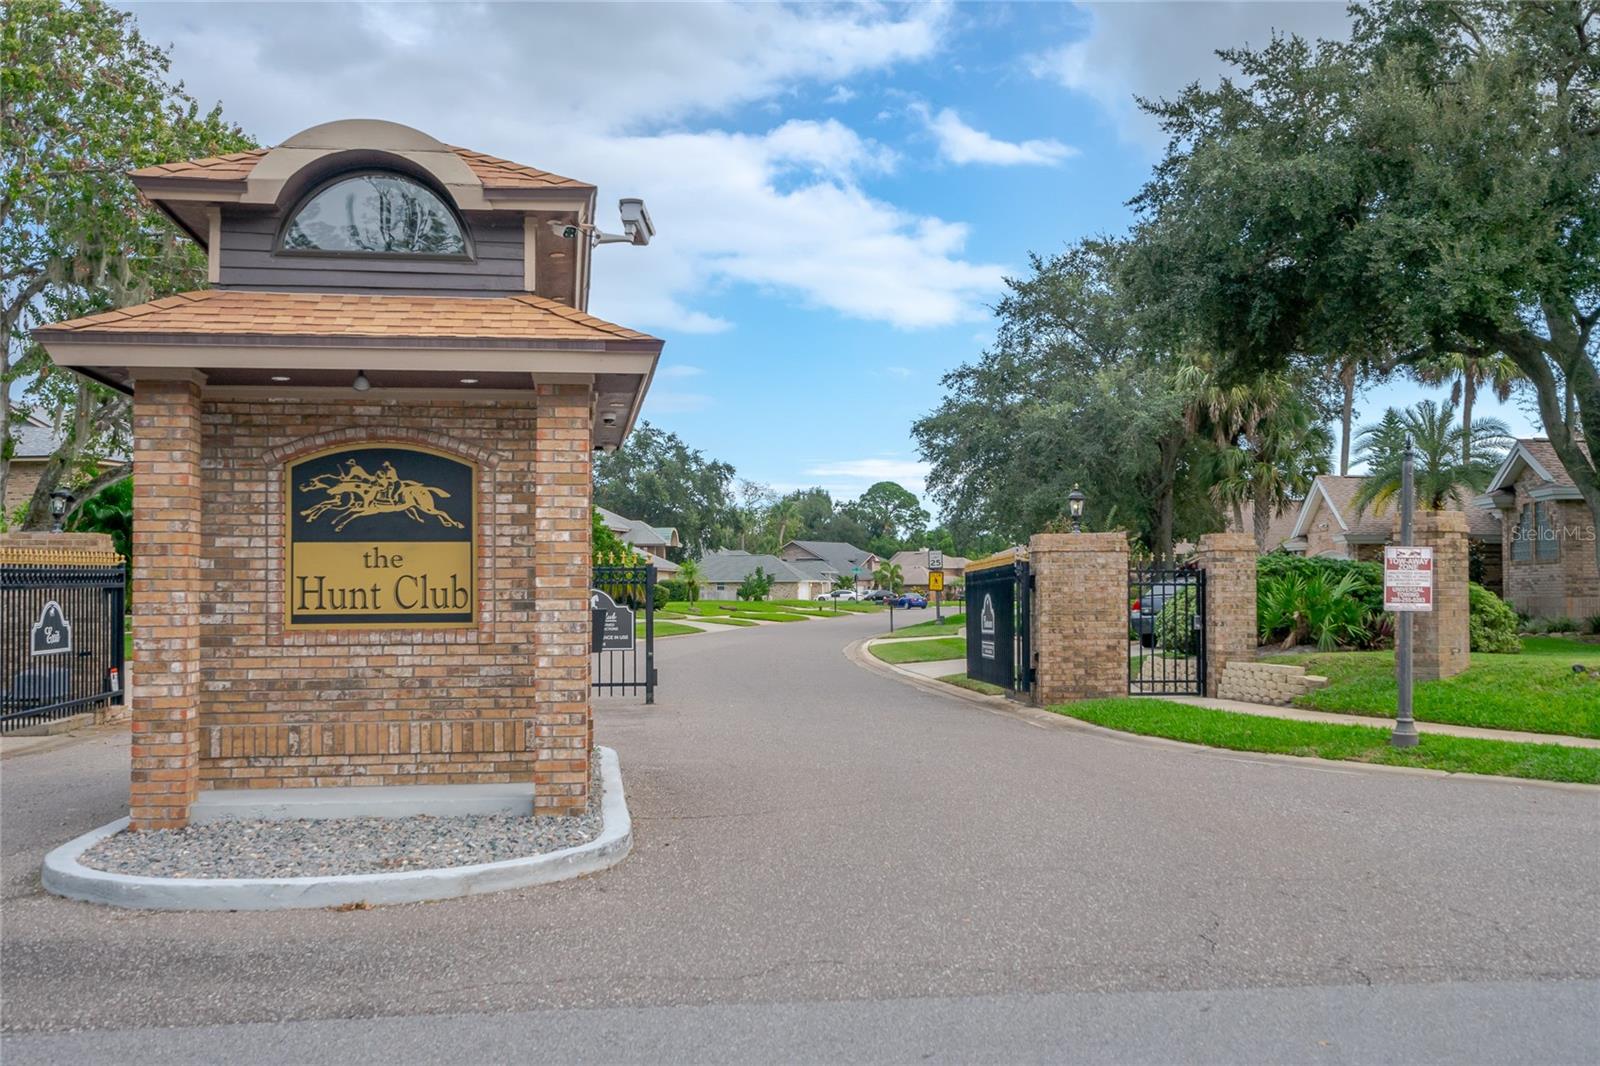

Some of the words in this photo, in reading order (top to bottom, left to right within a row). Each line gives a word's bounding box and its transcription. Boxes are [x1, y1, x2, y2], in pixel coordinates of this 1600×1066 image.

[363, 546, 404, 569] the
[930, 559, 941, 567] 25
[296, 575, 382, 610] Hunt
[394, 573, 469, 610] Club
